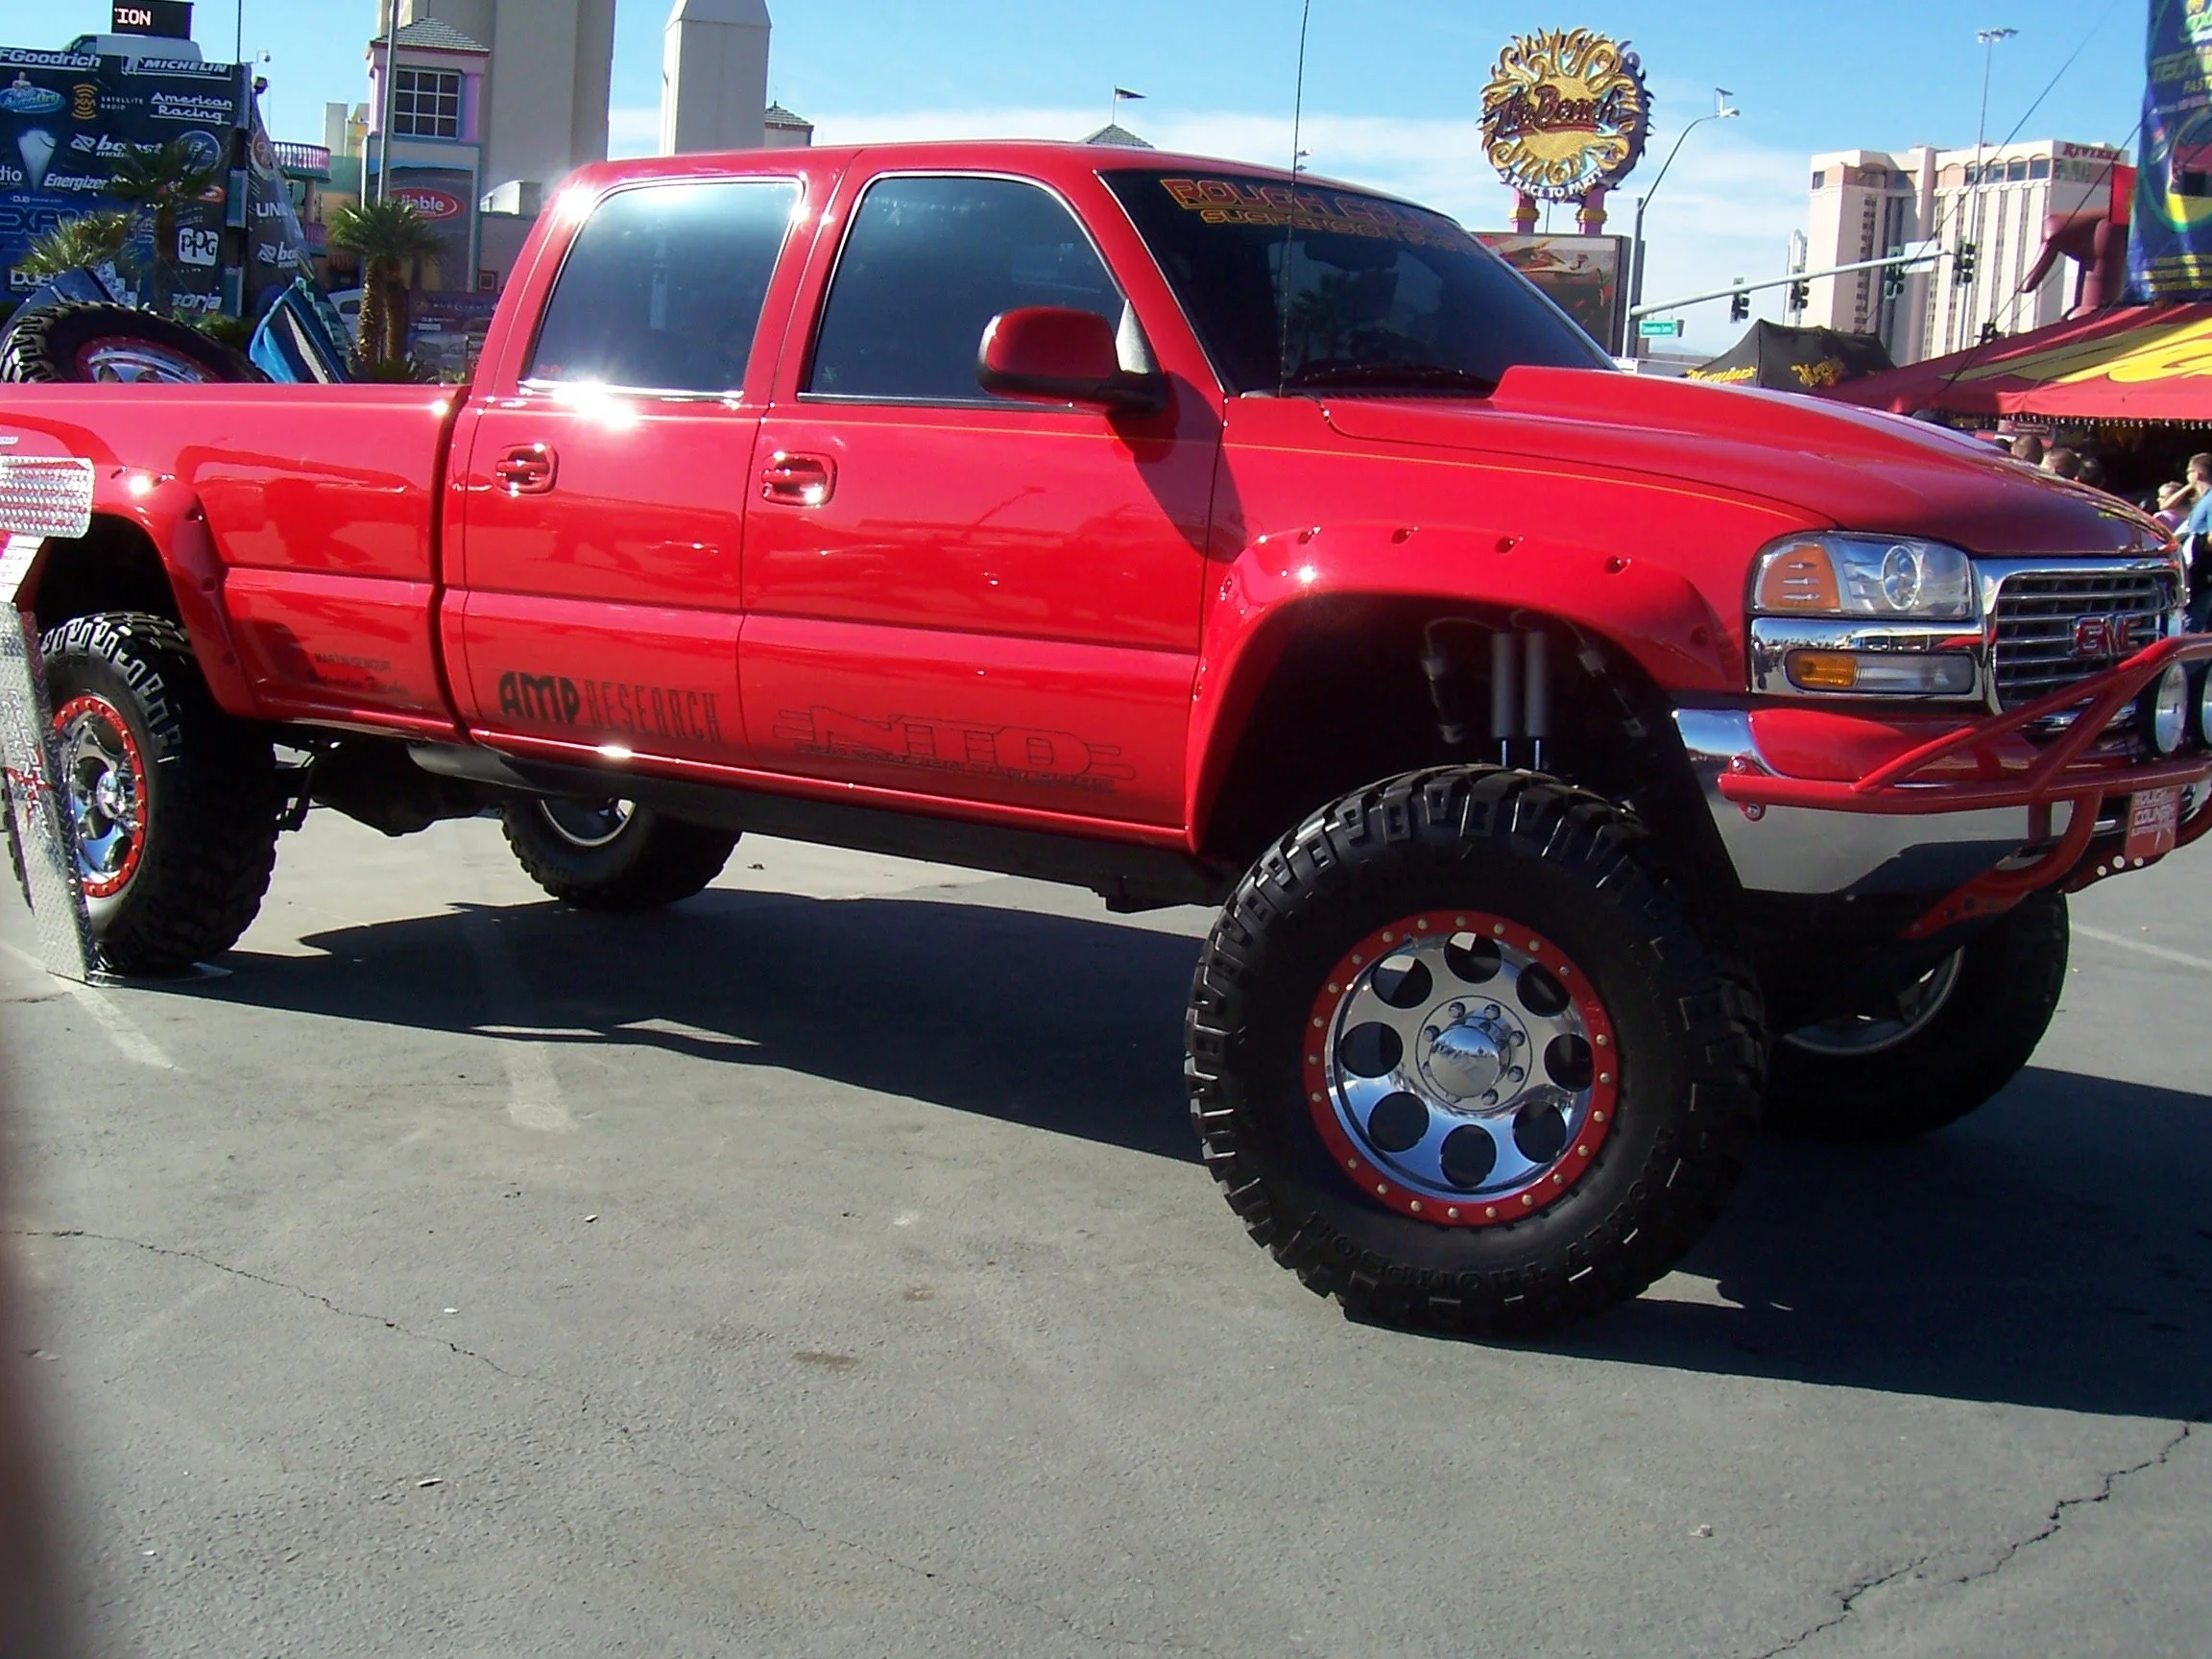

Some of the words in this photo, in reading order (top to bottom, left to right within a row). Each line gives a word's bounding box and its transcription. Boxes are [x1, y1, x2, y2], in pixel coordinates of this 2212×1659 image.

[114, 8, 152, 26] ION
[144, 59, 228, 74] MICHELIN
[151, 92, 232, 108] American
[158, 105, 222, 125] Racing
[44, 173, 109, 191] Energizer
[1510, 175, 1545, 198] PLACE
[1548, 186, 1565, 198] TO
[1568, 166, 1603, 196] PARTY
[181, 230, 217, 257] PPG
[497, 671, 580, 725] AMP
[584, 679, 721, 743] RESEARCH
